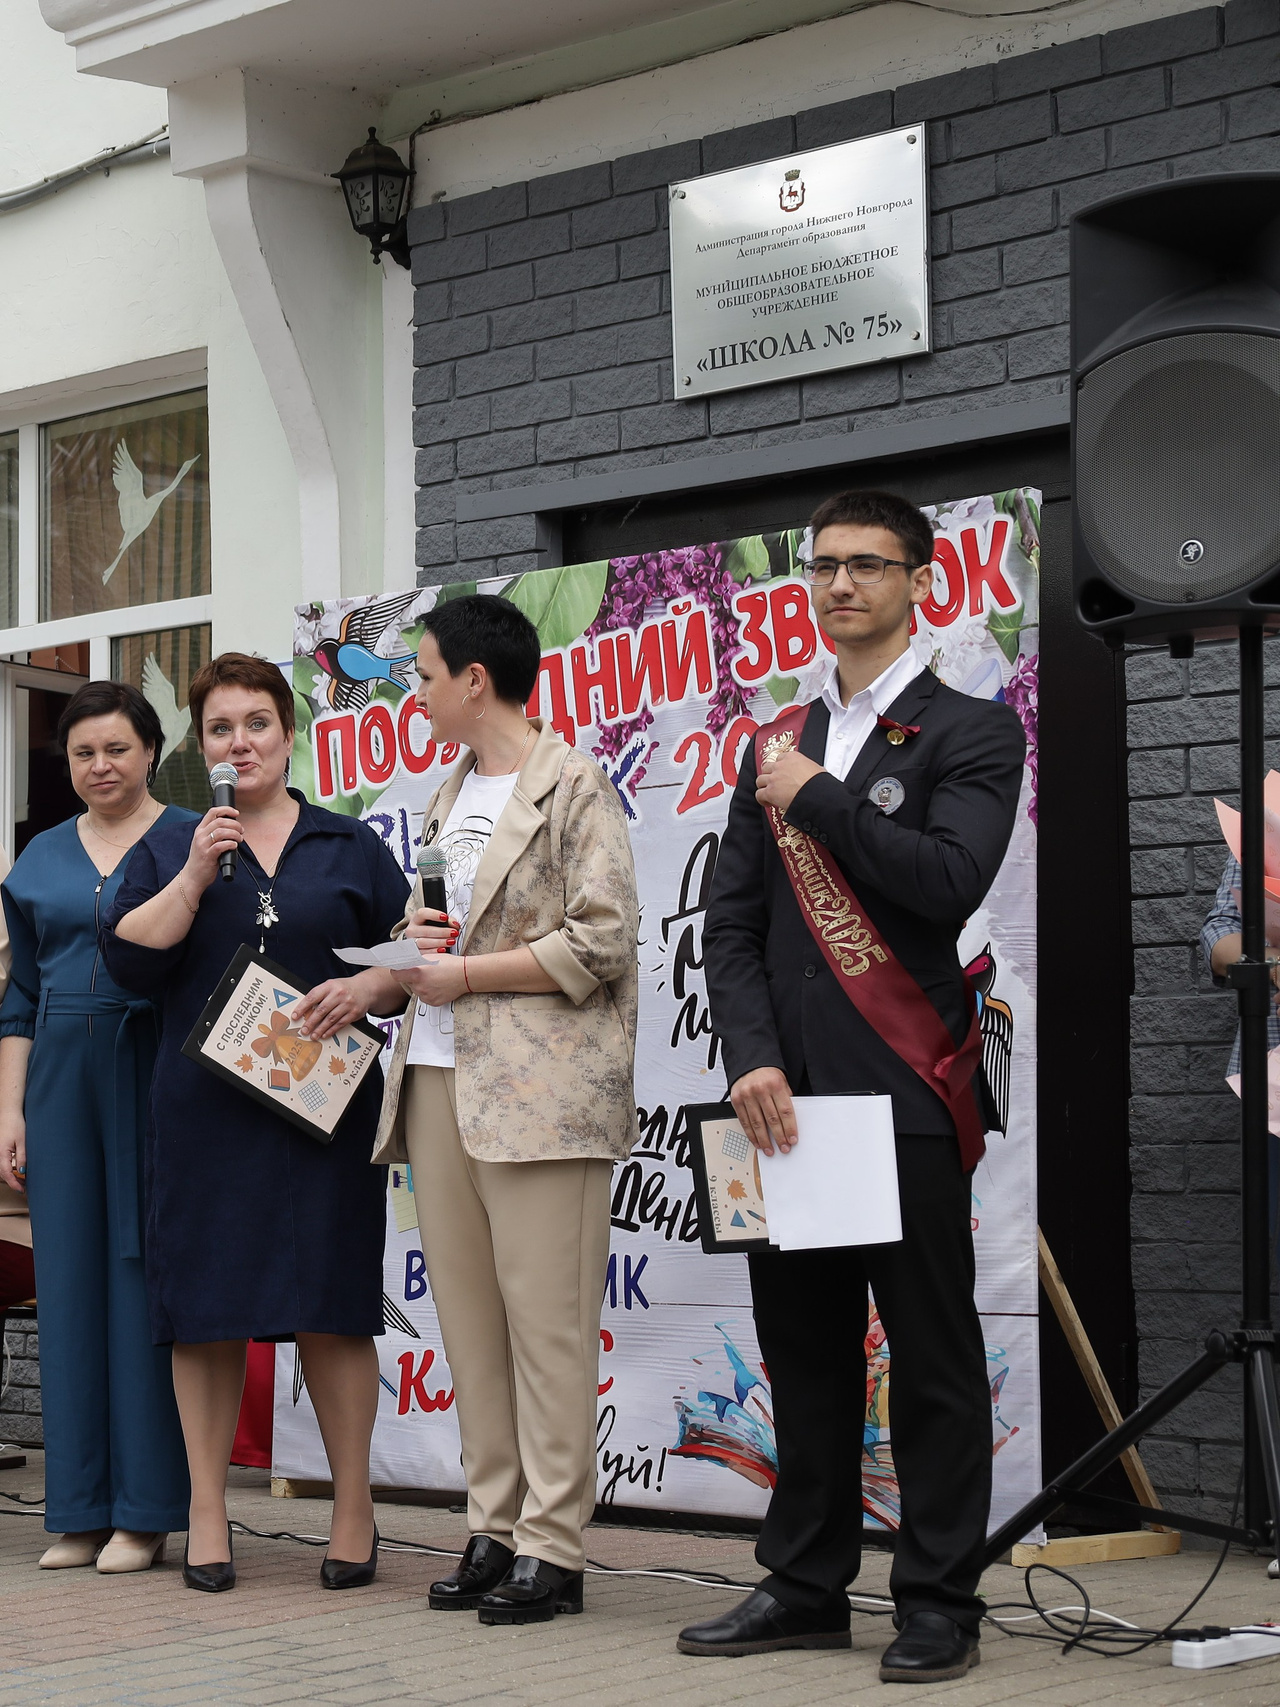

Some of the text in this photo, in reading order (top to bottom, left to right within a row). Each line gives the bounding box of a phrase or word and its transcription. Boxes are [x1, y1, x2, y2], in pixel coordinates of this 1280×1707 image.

[695, 197, 913, 254] Администрация города Нижнего Новгорода
[736, 223, 866, 260] Департамент образования
[696, 245, 899, 299] МУНИЦИПАЛЬНОЕ БЮДЖЕТНОЕ
[717, 266, 875, 310] ОБЩЕОБРАЗОВАТЕЛЬНОЕ
[751, 290, 839, 319] УЧРЕЖДЕНИЕ
[696, 312, 903, 372] «ШКОЛА № 75»
[315, 601, 713, 797] ПОСДНИЙ
[734, 520, 1018, 681] ЗВОК
[809, 895, 889, 977] 2025
[217, 977, 263, 1051] С ПОСЛЕДНИМ
[233, 993, 268, 1047] ЗВОНКОМ!
[285, 1040, 304, 1066] 2025
[342, 1040, 375, 1088] 9 классы
[708, 1174, 722, 1234] 9 классы
